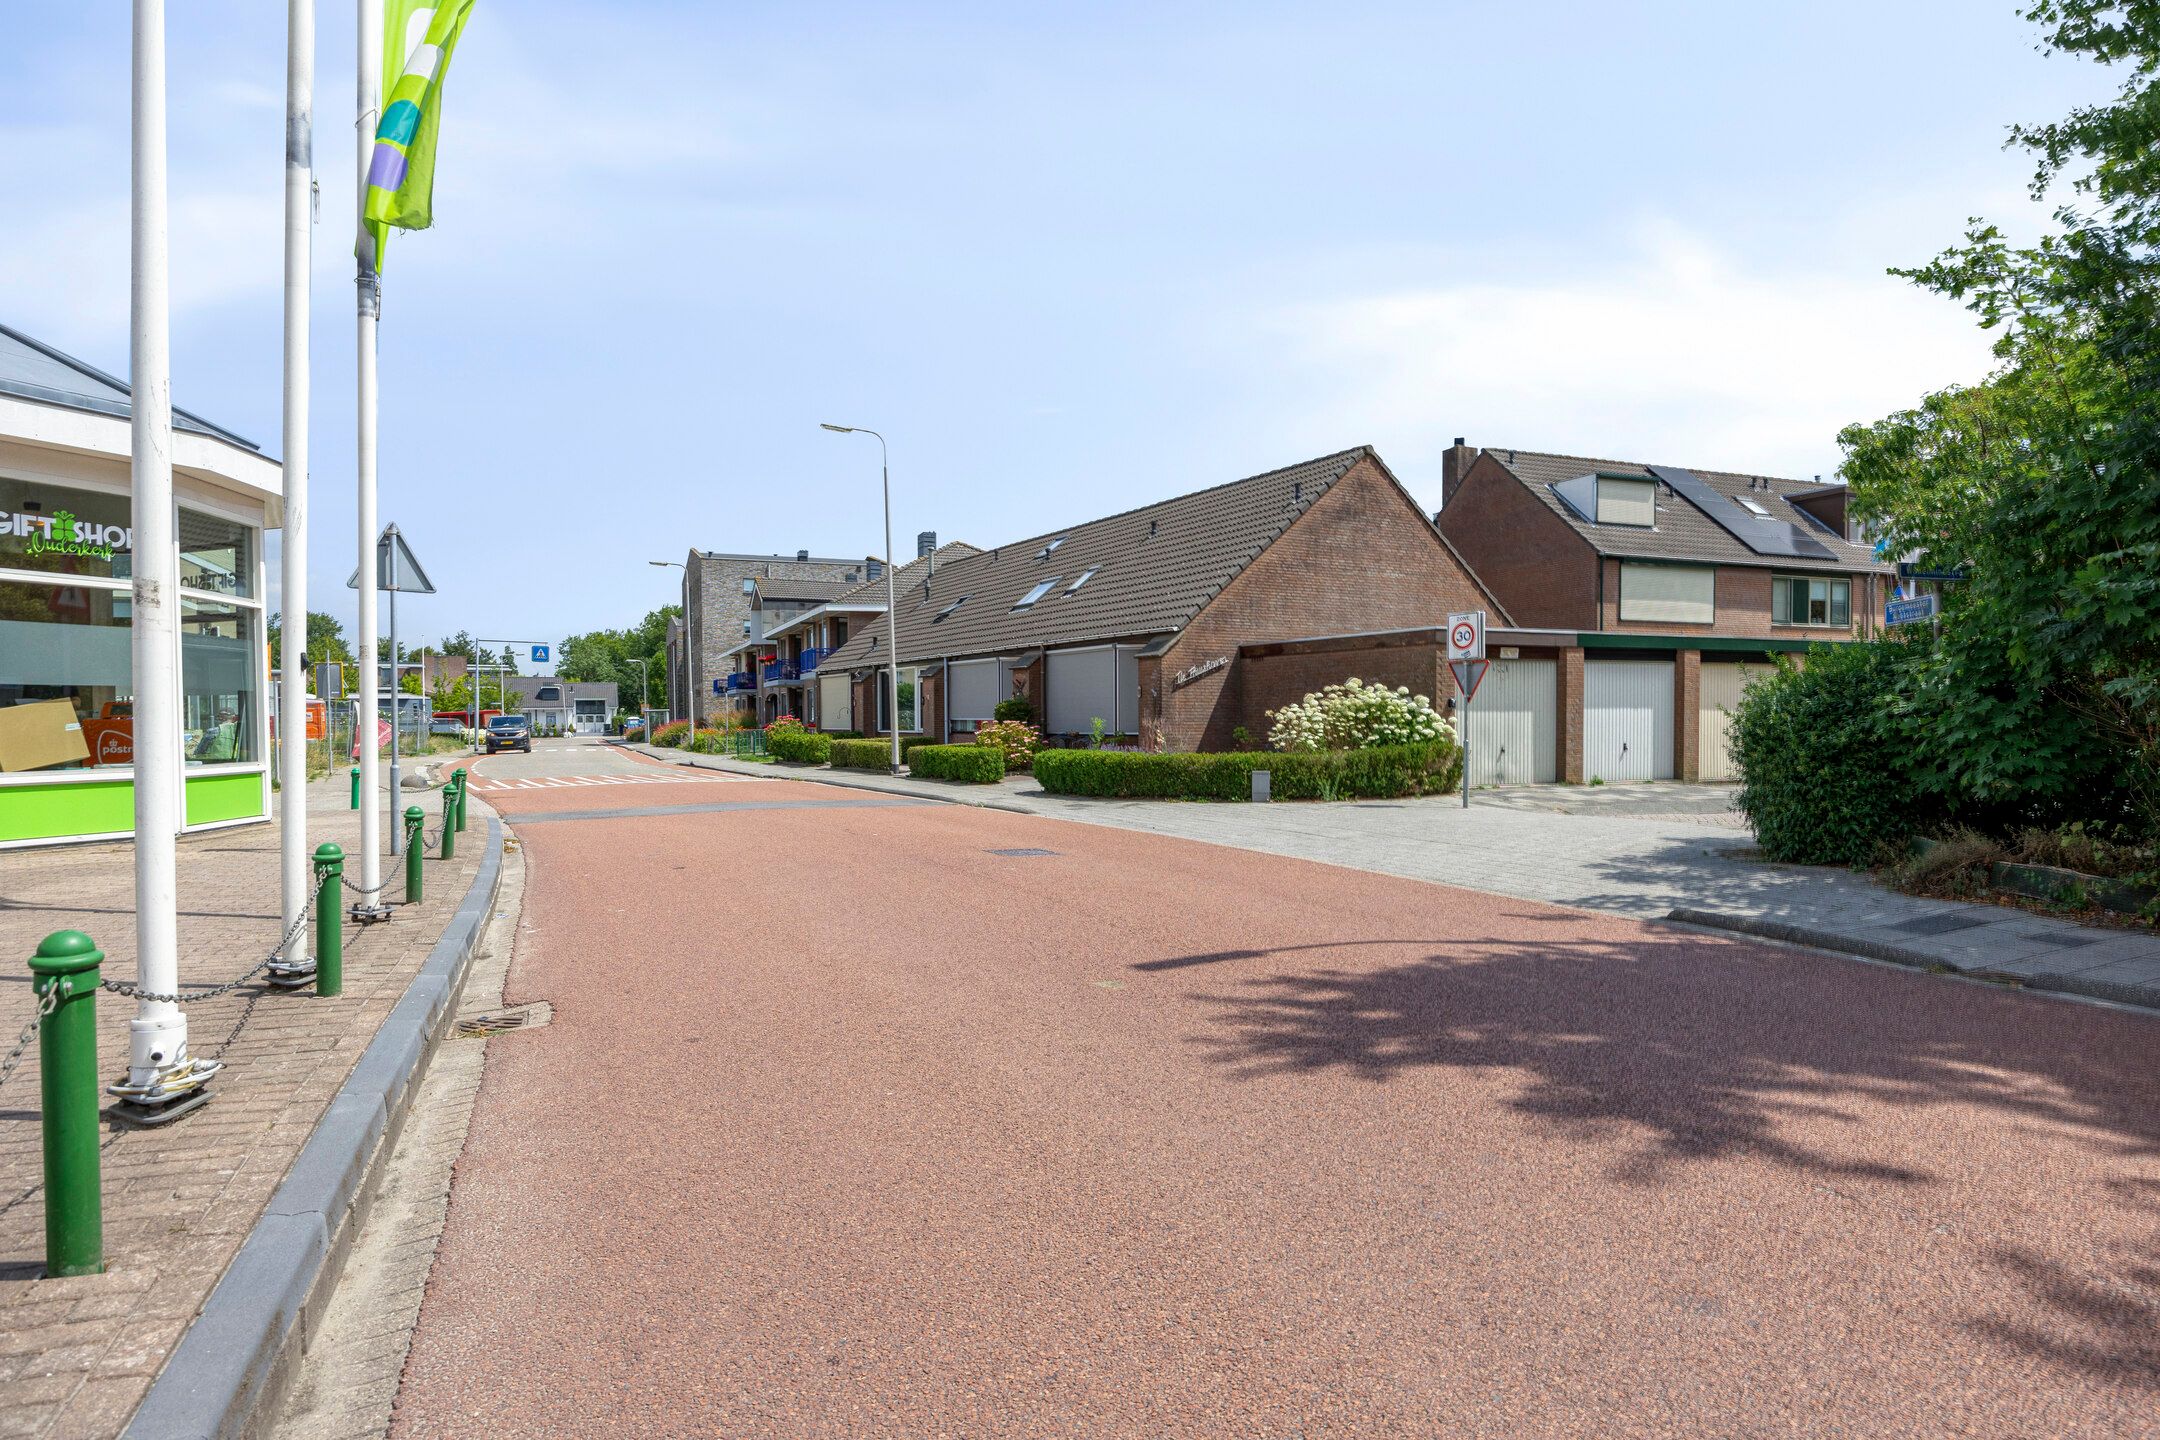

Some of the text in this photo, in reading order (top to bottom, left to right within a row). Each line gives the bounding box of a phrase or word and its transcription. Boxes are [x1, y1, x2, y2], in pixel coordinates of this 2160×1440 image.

[0, 510, 57, 540] GIFT
[32, 530, 116, 559] Ouderkerk
[1456, 631, 1470, 641] 30
